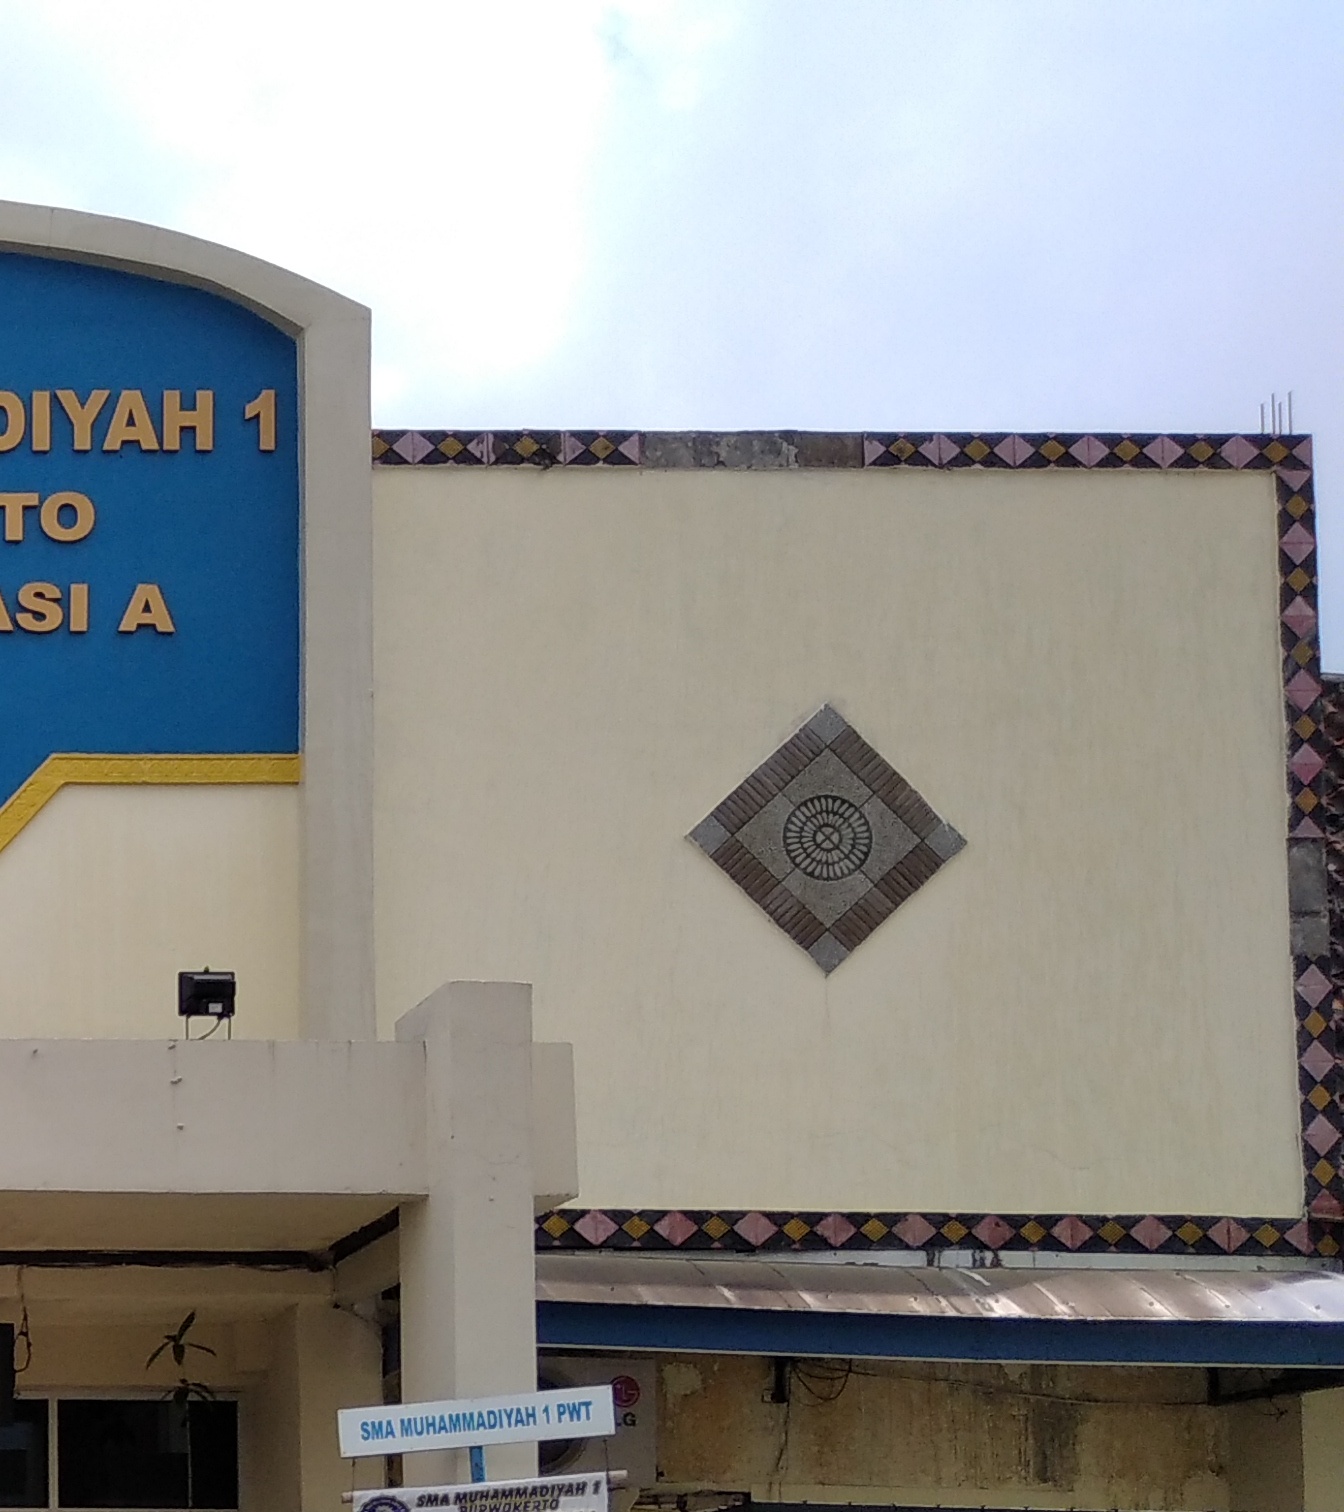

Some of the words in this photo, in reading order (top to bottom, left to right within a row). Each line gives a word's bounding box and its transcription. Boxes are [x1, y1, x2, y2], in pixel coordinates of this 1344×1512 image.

[242, 388, 279, 453] 1
[117, 583, 177, 635] A
[361, 1419, 396, 1441] SMA
[399, 1405, 537, 1438] MUHAMMADIYAH
[541, 1403, 551, 1425] 1
[556, 1400, 594, 1423] PWT
[416, 1493, 451, 1508] SMA
[454, 1480, 588, 1506] MUHAMMADIYAH
[591, 1479, 602, 1496] 1
